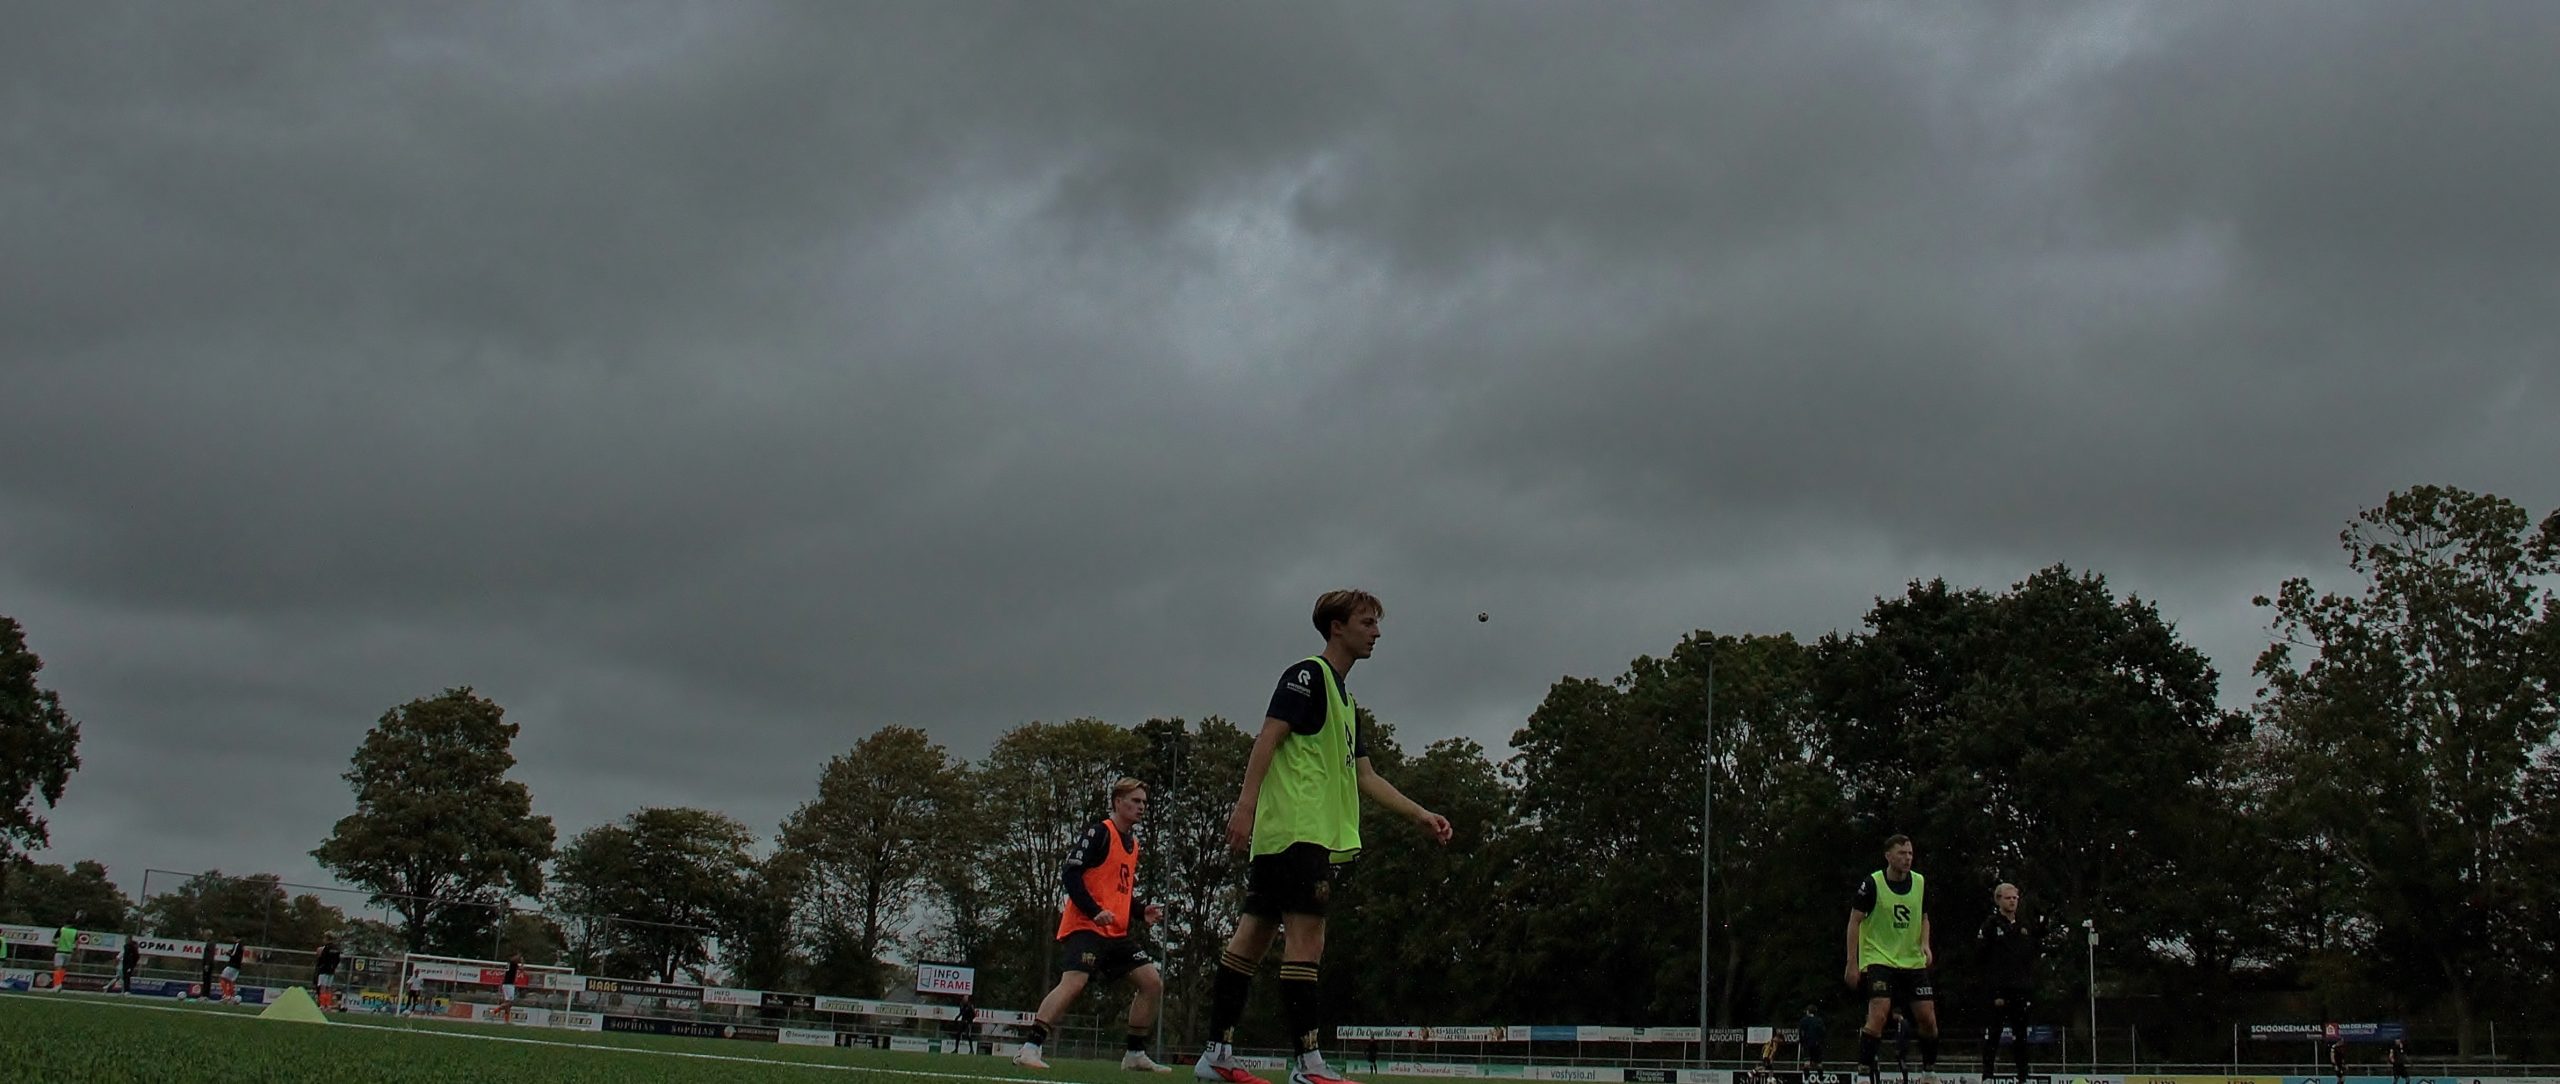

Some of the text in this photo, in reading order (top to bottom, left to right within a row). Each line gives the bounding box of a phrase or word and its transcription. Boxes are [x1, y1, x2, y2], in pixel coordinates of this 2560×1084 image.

[933, 968, 960, 979] INFO
[588, 979, 618, 992] HAAG
[933, 979, 971, 991] FRAME
[2251, 1024, 2323, 1033] SCHOONGEMAK.NL
[1709, 1034, 1744, 1042] ADVOCATEN
[1551, 1069, 1596, 1081] vosfysio.nl
